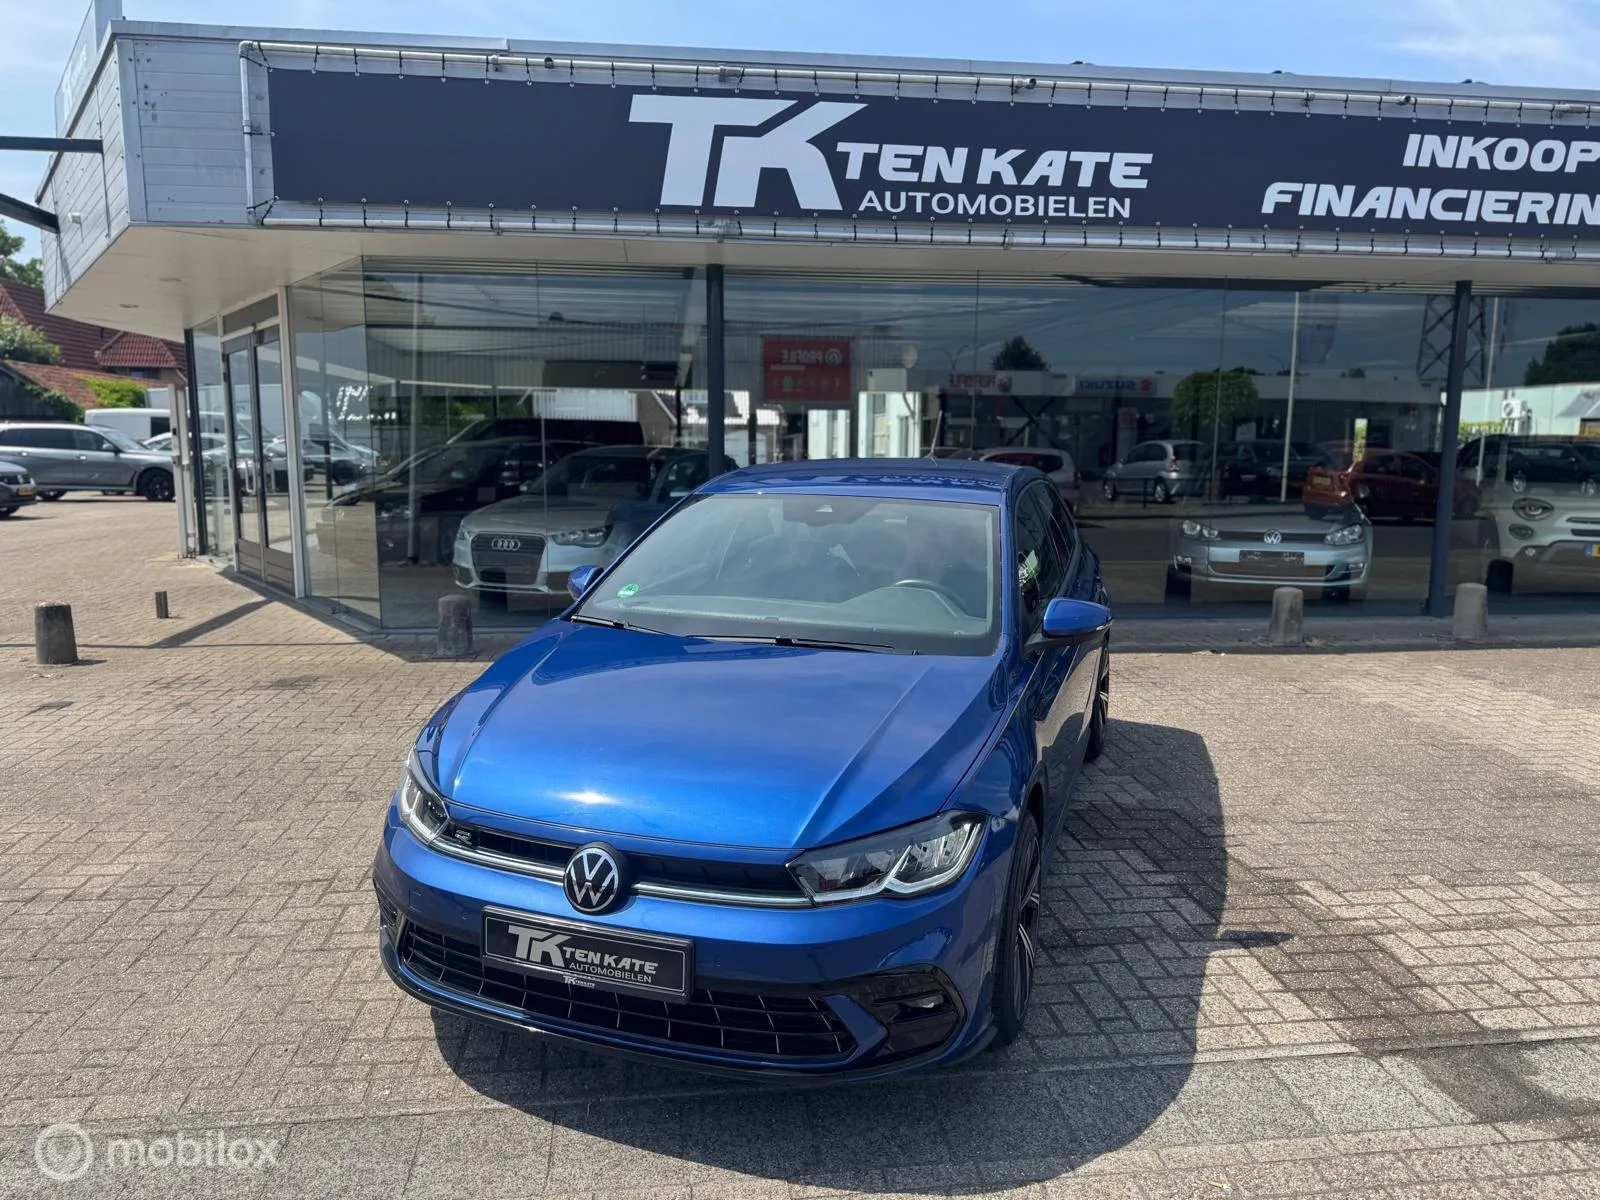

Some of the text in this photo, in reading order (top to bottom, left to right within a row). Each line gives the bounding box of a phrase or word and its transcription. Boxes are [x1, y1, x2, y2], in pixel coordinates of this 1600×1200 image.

[629, 93, 868, 211] TK
[836, 142, 1153, 189] TEN KATE
[1402, 133, 1600, 173] INKOOP
[858, 190, 1130, 219] AUTOMOBIELEN
[1261, 181, 1600, 226] FINANCIERIN
[508, 924, 572, 968] TK
[562, 946, 659, 975] TEN KATE
[569, 962, 652, 983] AUTOMOBIELEN
